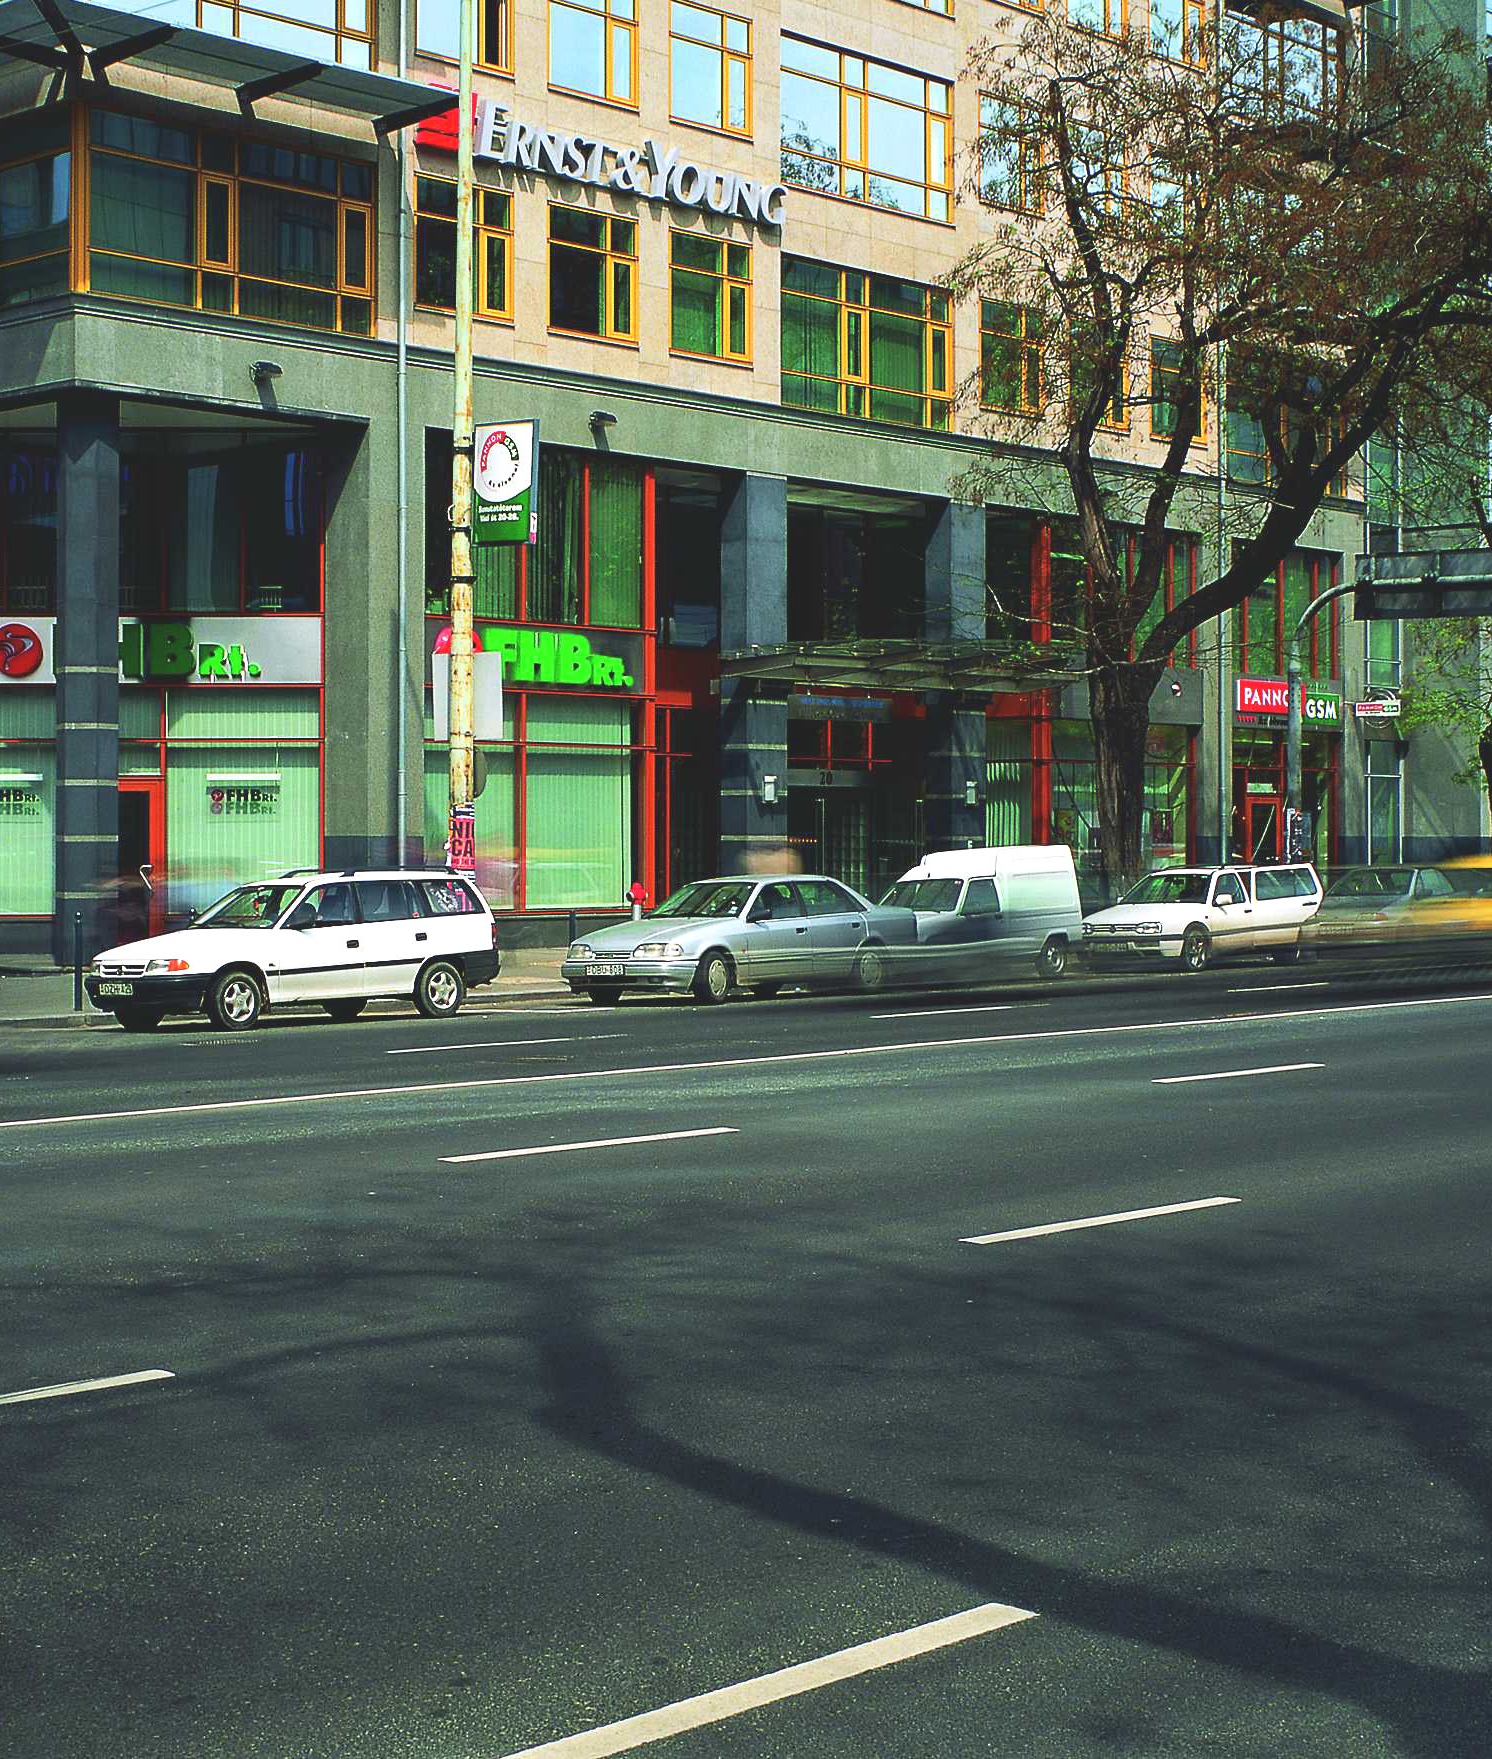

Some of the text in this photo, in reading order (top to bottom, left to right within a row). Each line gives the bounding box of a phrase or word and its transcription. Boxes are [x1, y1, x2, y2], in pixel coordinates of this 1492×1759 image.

[474, 99, 788, 226] ERNST & YOUNG
[1244, 687, 1338, 720] PANNO GSM
